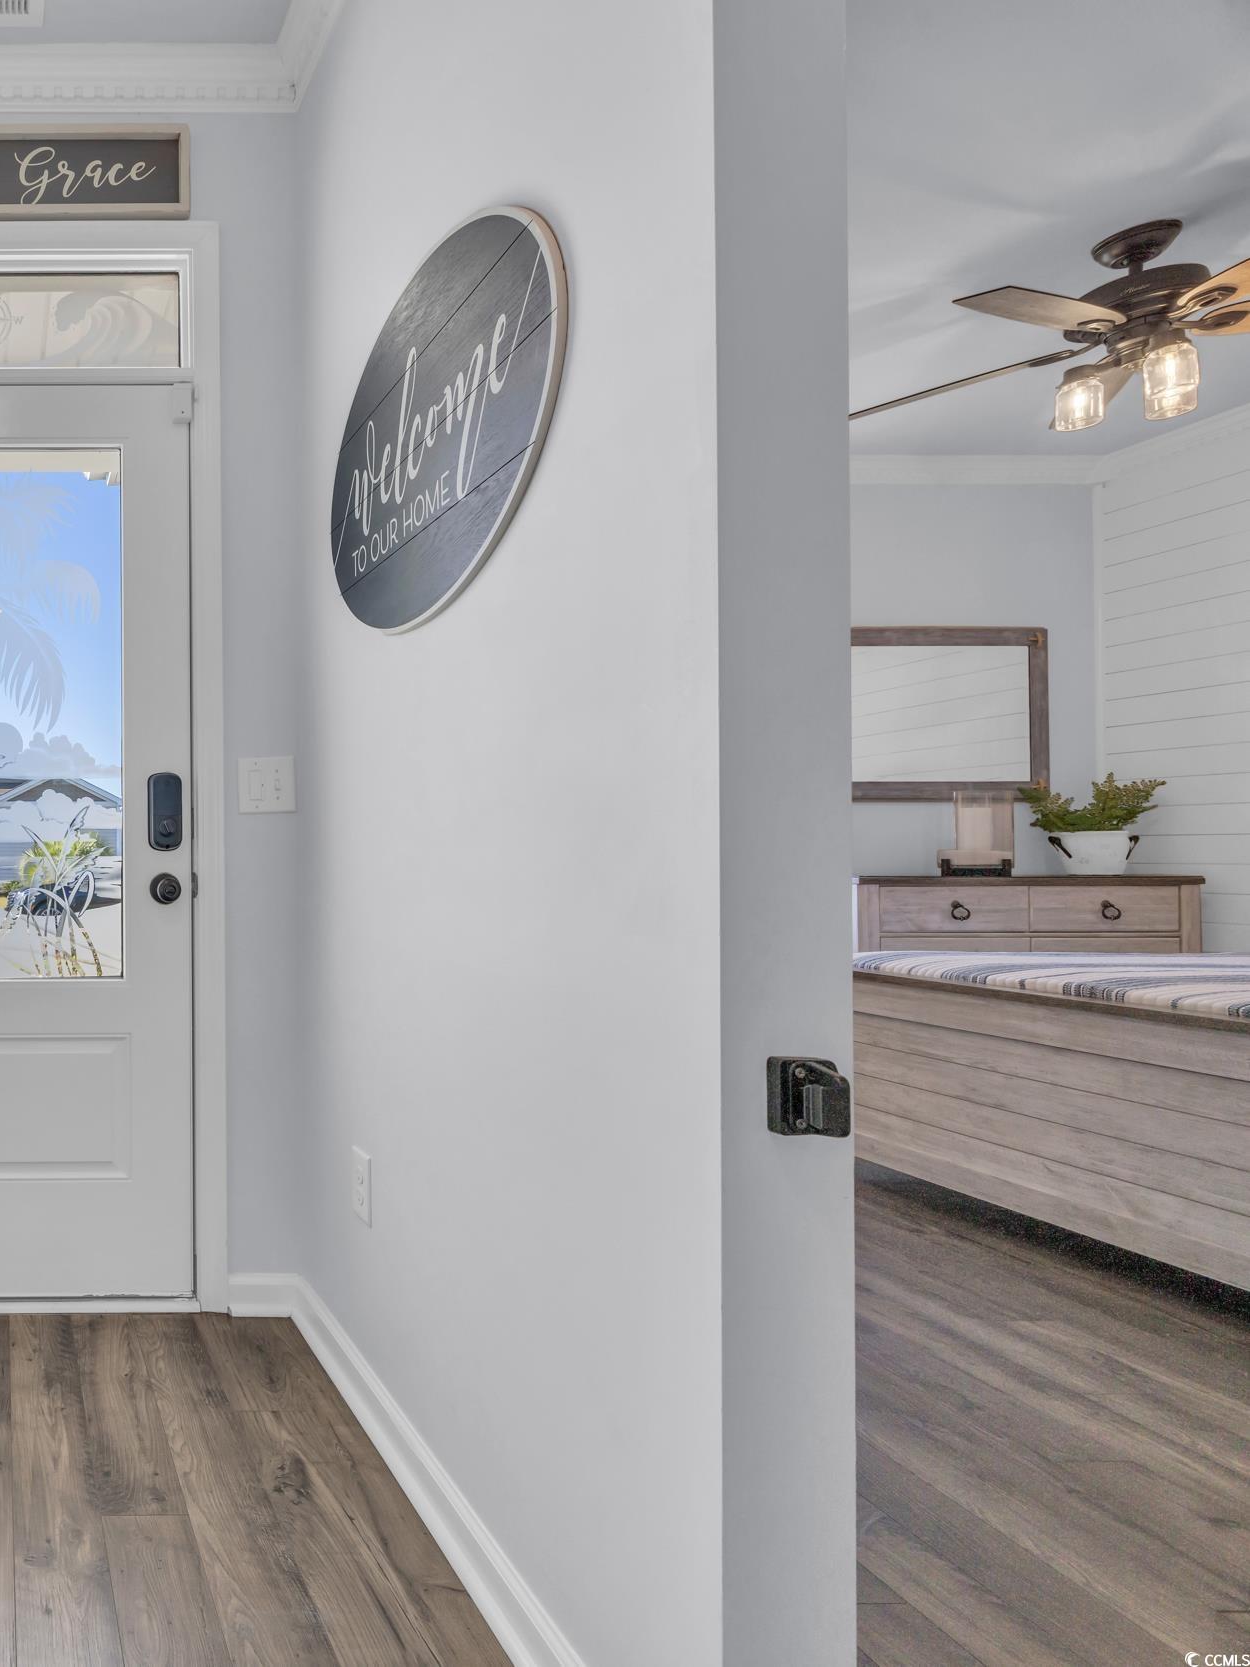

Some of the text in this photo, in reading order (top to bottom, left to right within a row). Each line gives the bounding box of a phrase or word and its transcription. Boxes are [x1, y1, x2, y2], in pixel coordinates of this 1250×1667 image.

[14, 146, 156, 205] Grace
[352, 470, 451, 577] TO OUR HOME
